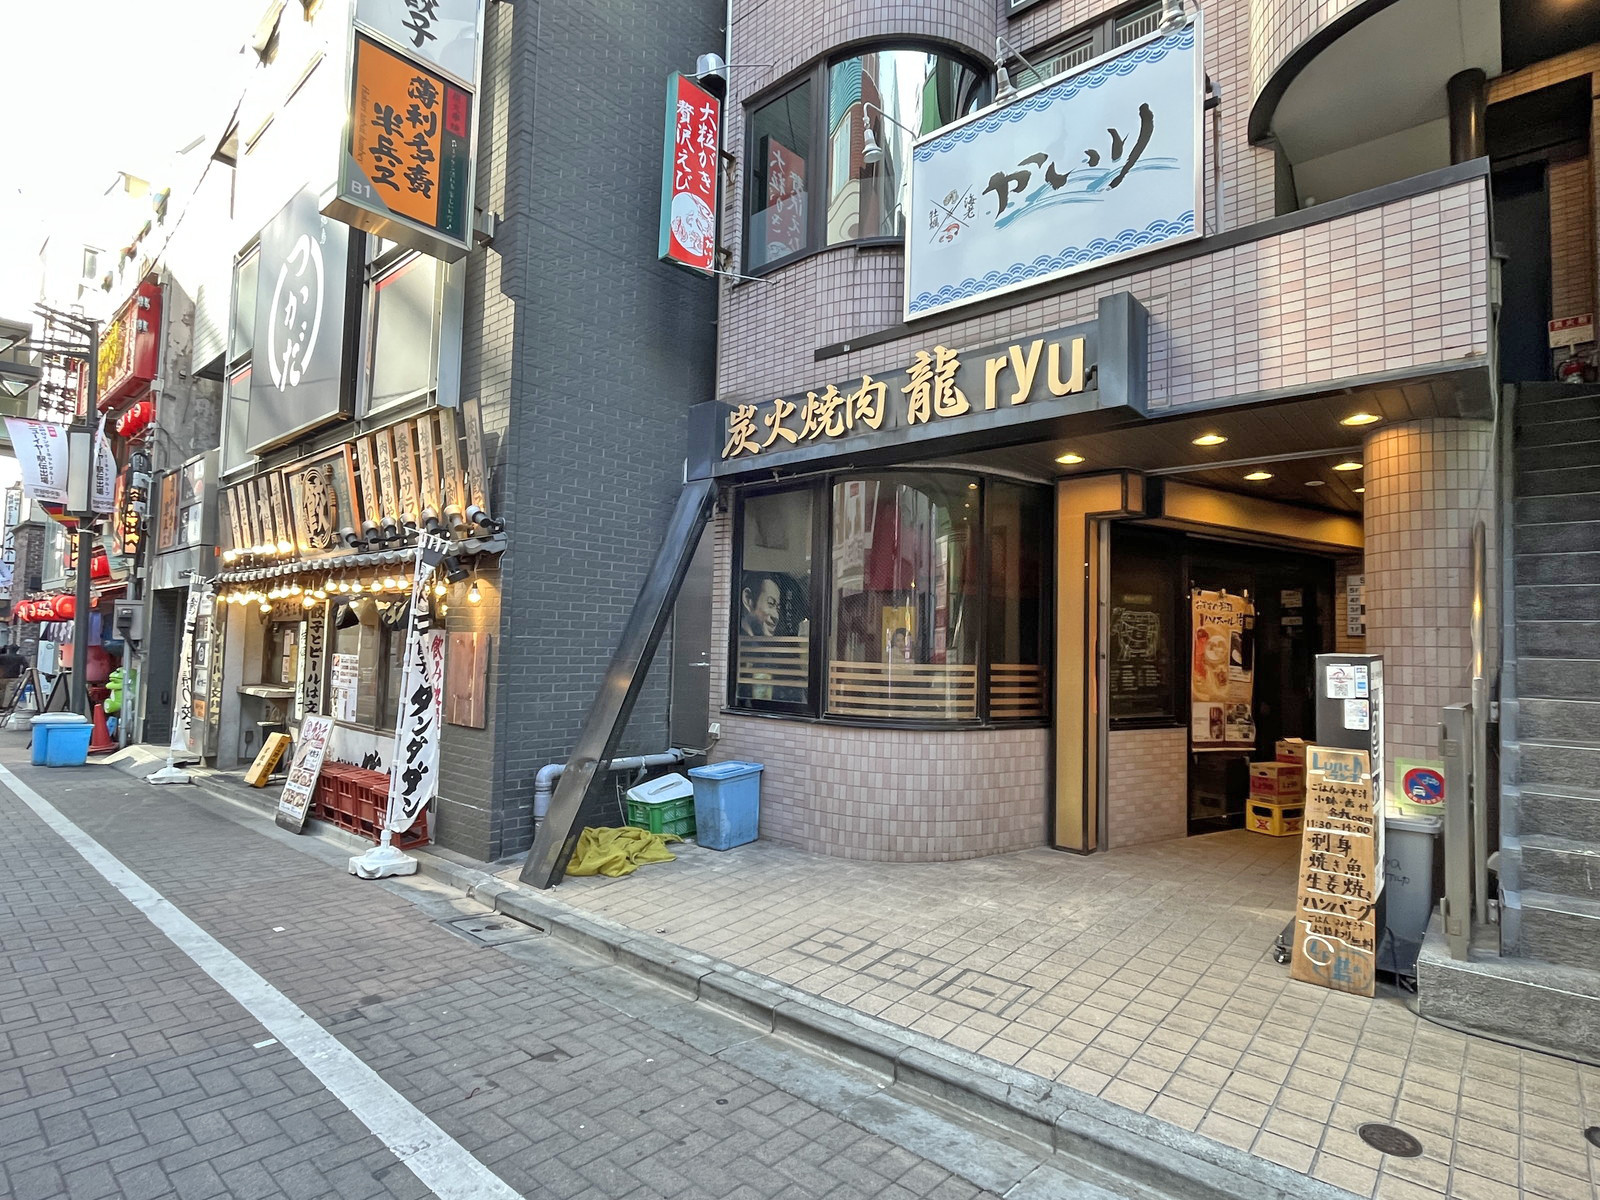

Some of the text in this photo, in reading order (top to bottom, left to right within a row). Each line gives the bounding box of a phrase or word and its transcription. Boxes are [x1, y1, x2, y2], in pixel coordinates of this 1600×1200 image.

[676, 100, 695, 190] 贅沢えび
[697, 102, 717, 194] 大粒がき
[351, 180, 371, 199] B1
[279, 234, 310, 392] つかだ
[721, 337, 1086, 460] 炭火焼肉 龍 ryu
[1312, 752, 1363, 774] Lunch
[1311, 833, 1352, 858] 刺身
[1308, 852, 1366, 878] 焼き魚
[1306, 872, 1372, 901] 生姜焼き
[1303, 897, 1376, 921] ハンバーグ
